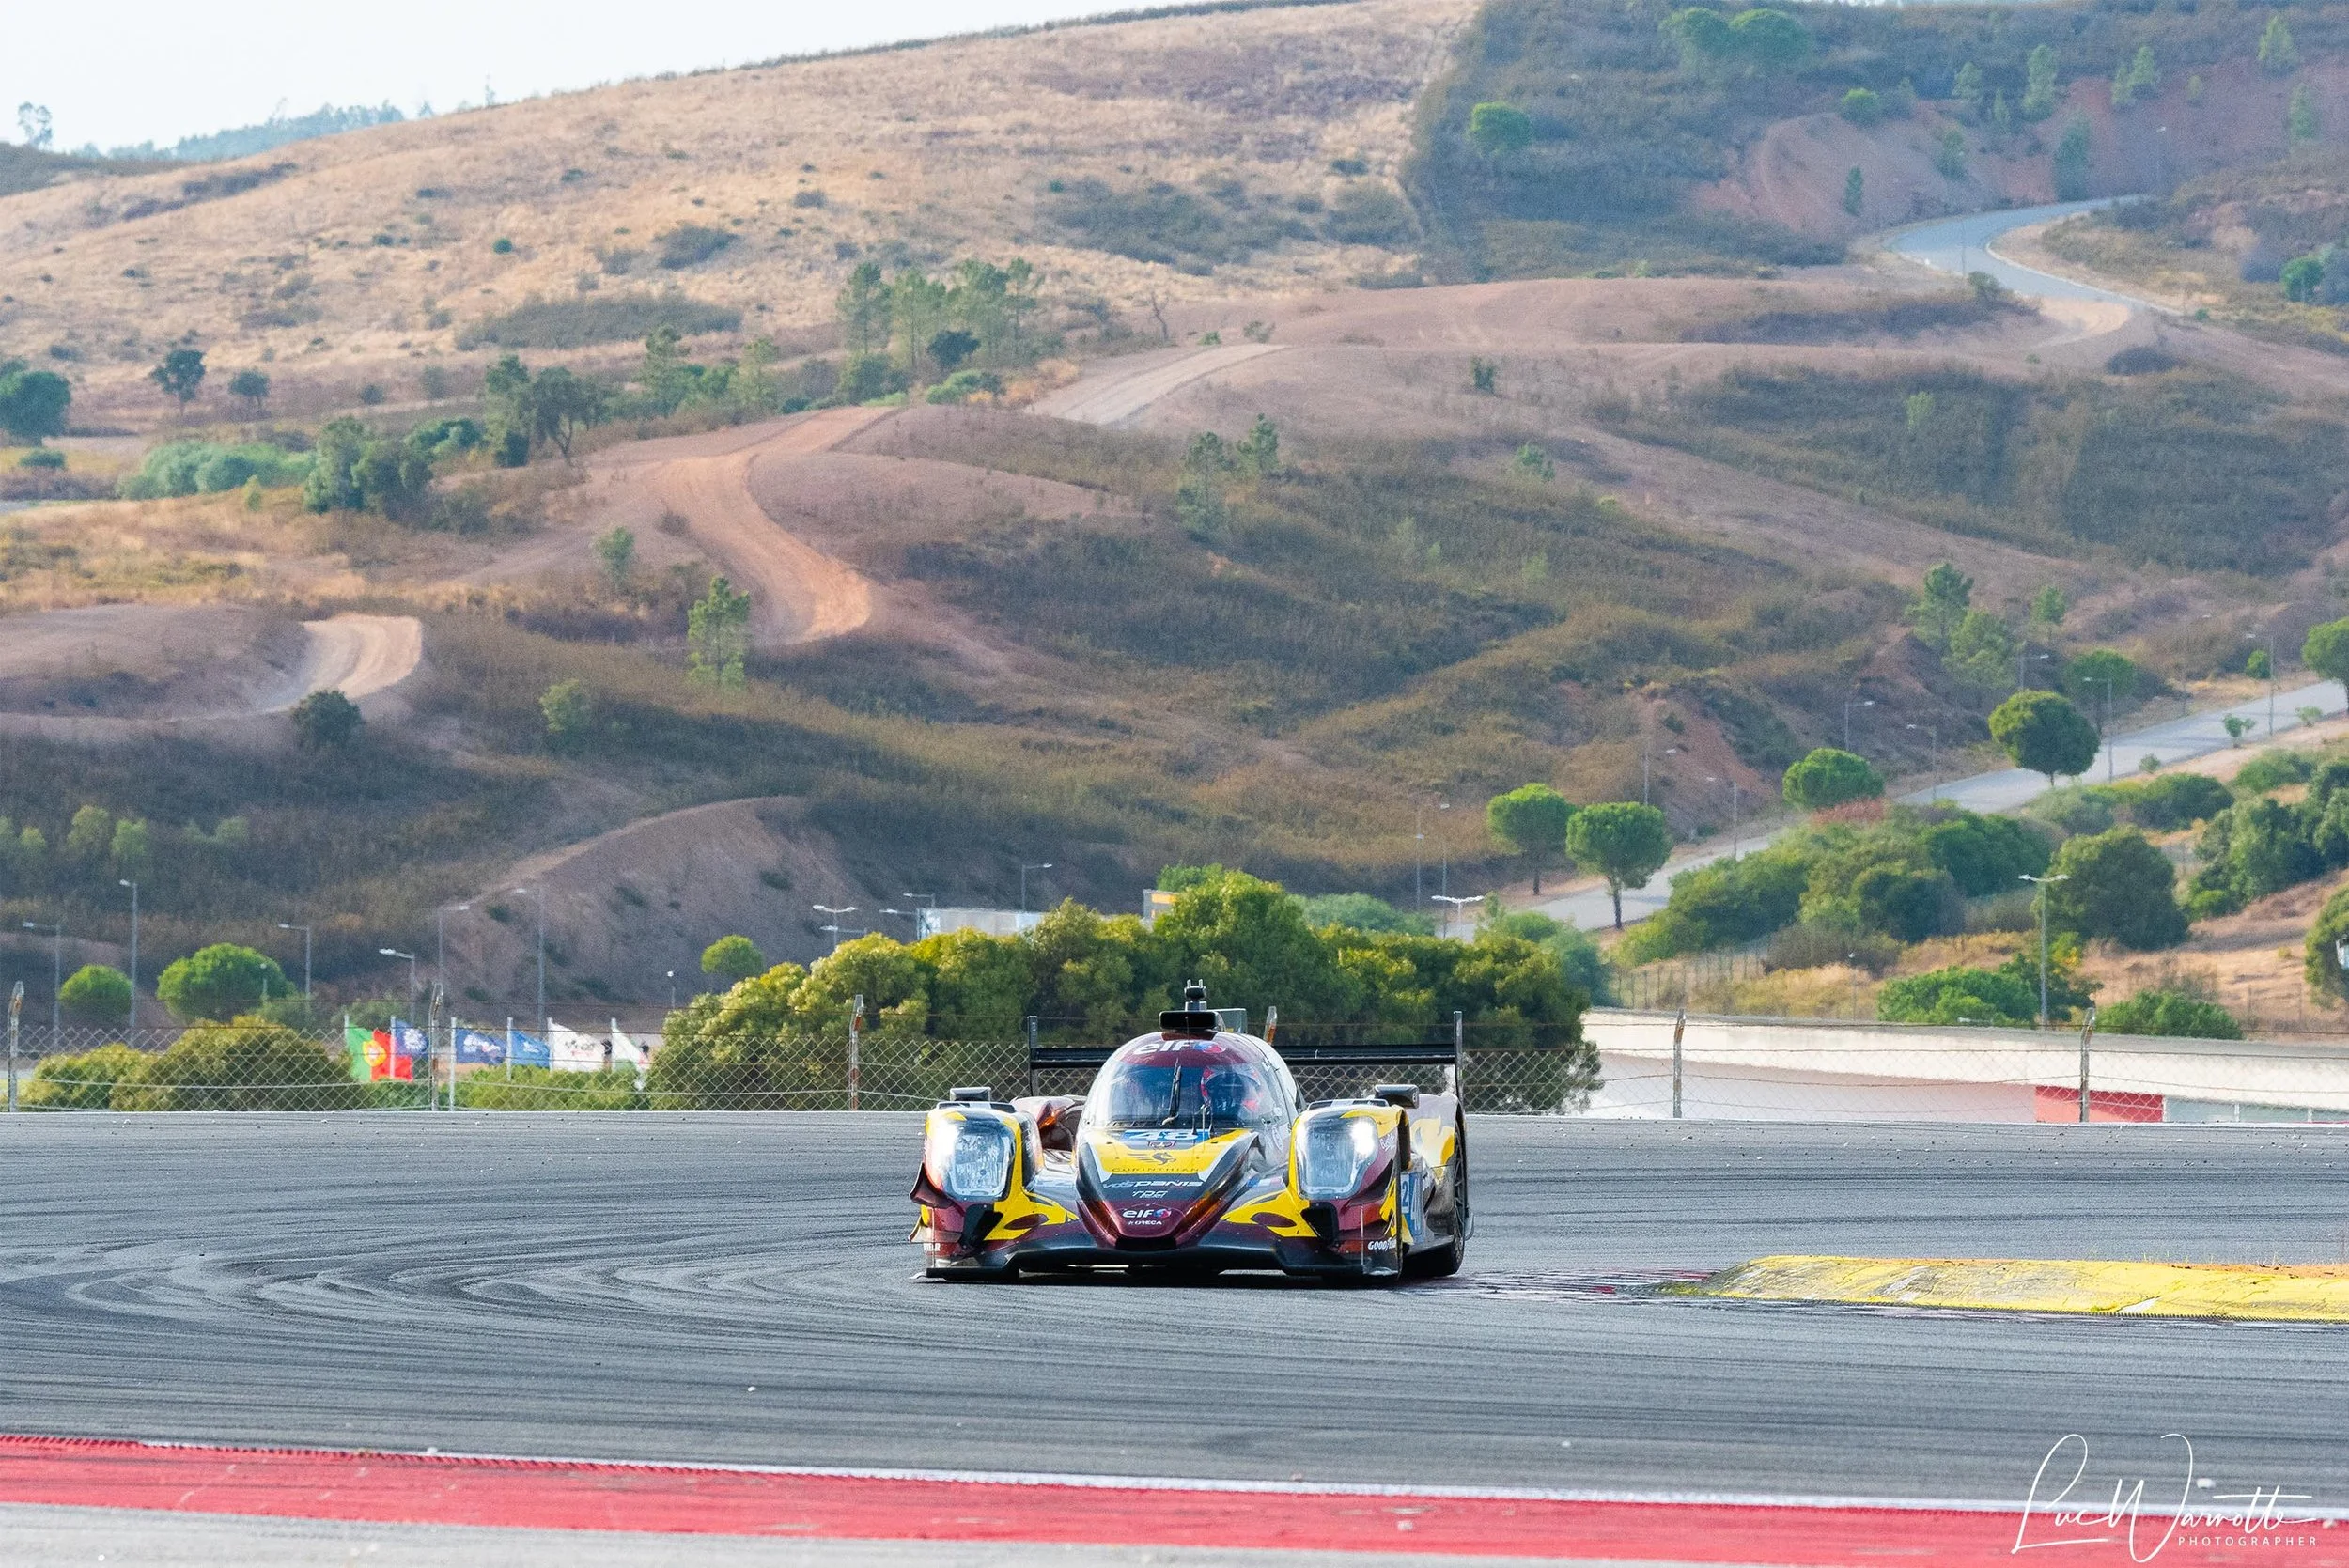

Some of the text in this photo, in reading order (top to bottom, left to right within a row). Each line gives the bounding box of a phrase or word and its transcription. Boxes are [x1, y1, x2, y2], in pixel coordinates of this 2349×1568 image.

[1133, 1040, 1194, 1054] elf
[1129, 1129, 1199, 1140] 48
[1123, 1209, 1154, 1218] elf
